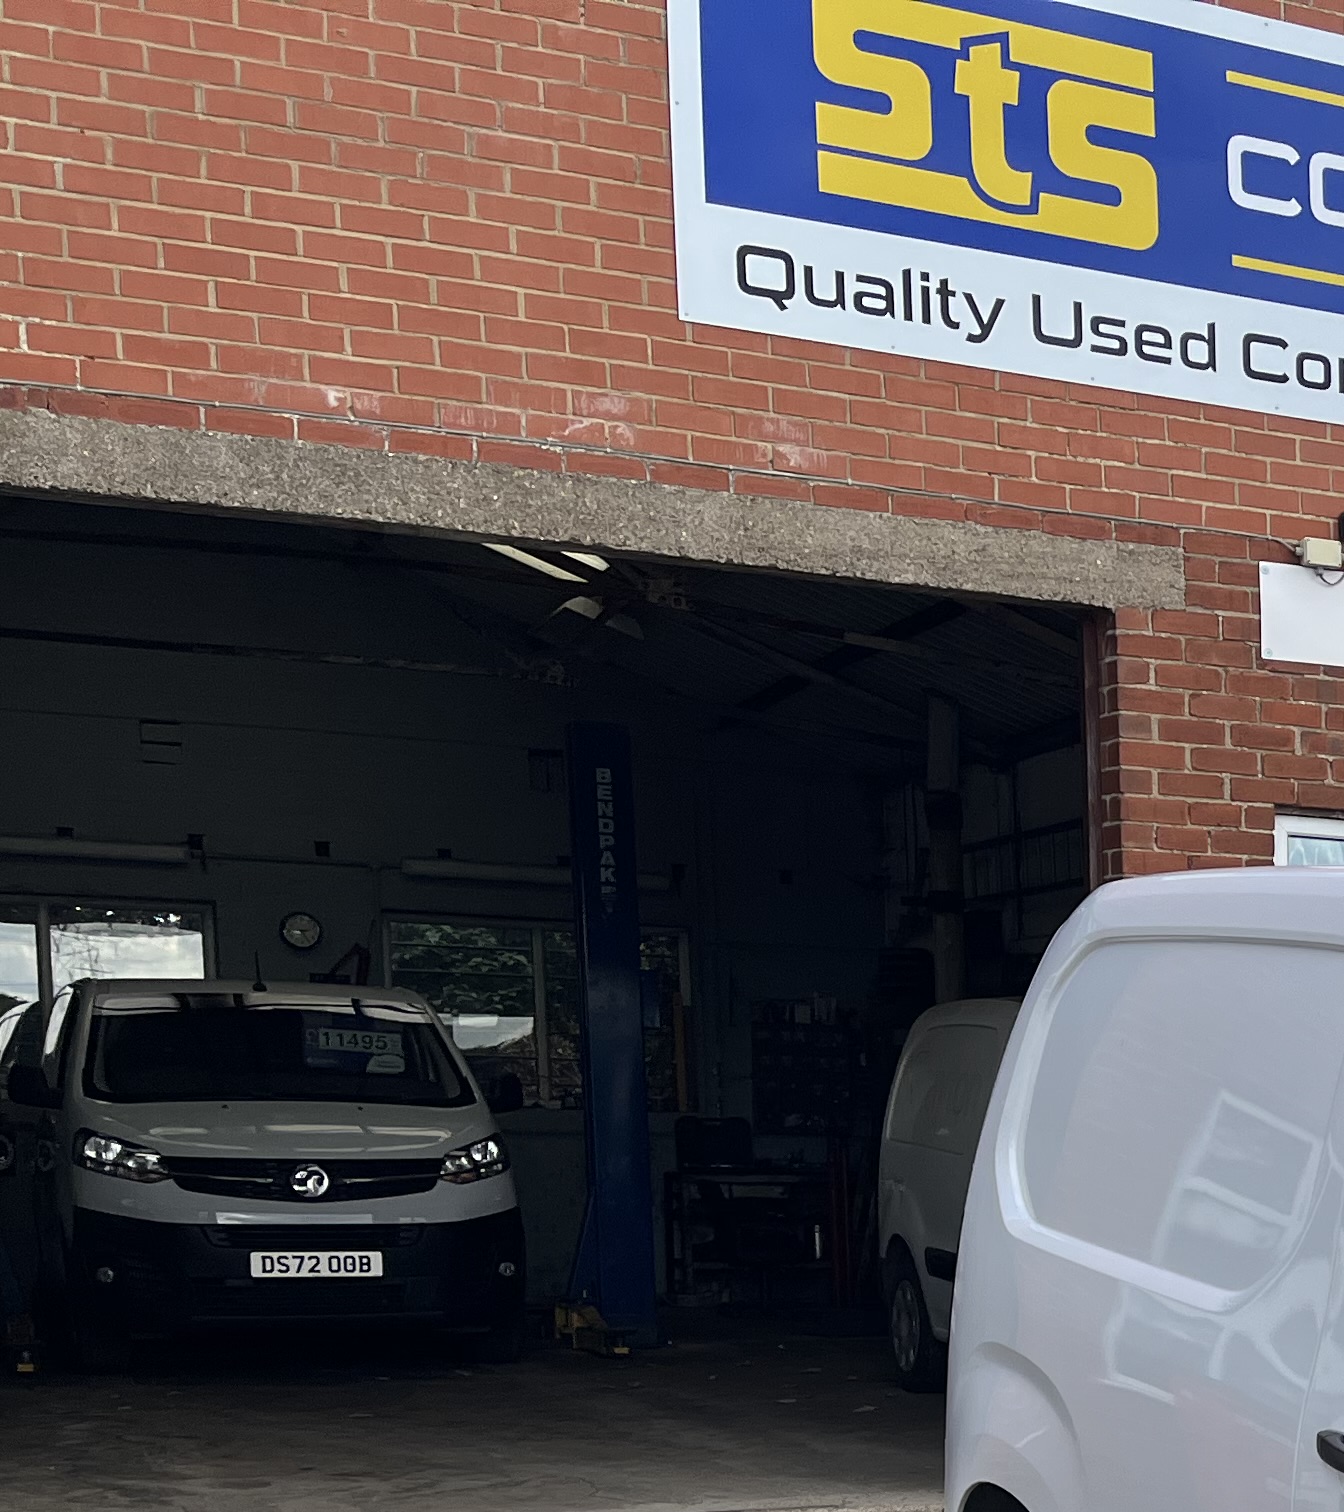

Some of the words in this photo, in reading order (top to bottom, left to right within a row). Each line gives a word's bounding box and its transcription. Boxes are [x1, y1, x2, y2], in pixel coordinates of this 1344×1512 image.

[736, 245, 1005, 343] Quality
[1032, 294, 1218, 372] Used
[261, 1255, 322, 1274] DS72
